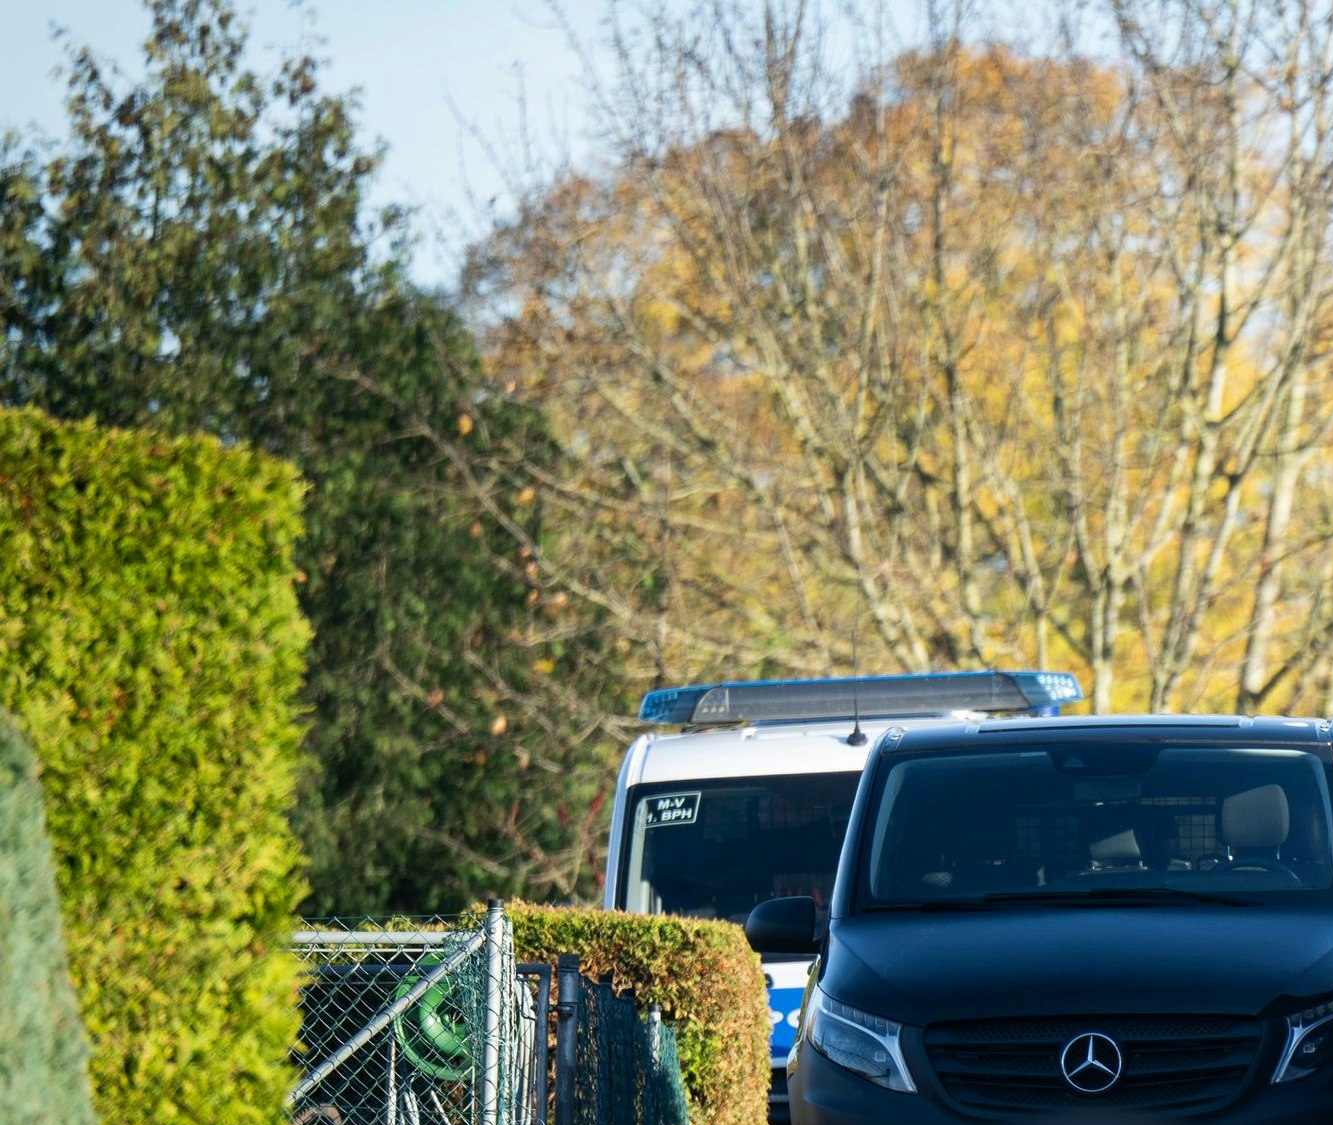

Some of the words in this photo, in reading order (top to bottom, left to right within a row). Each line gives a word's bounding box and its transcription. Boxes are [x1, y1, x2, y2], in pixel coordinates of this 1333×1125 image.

[657, 797, 686, 811] M-V
[647, 811, 657, 823] 1.
[661, 807, 693, 821] BPH
